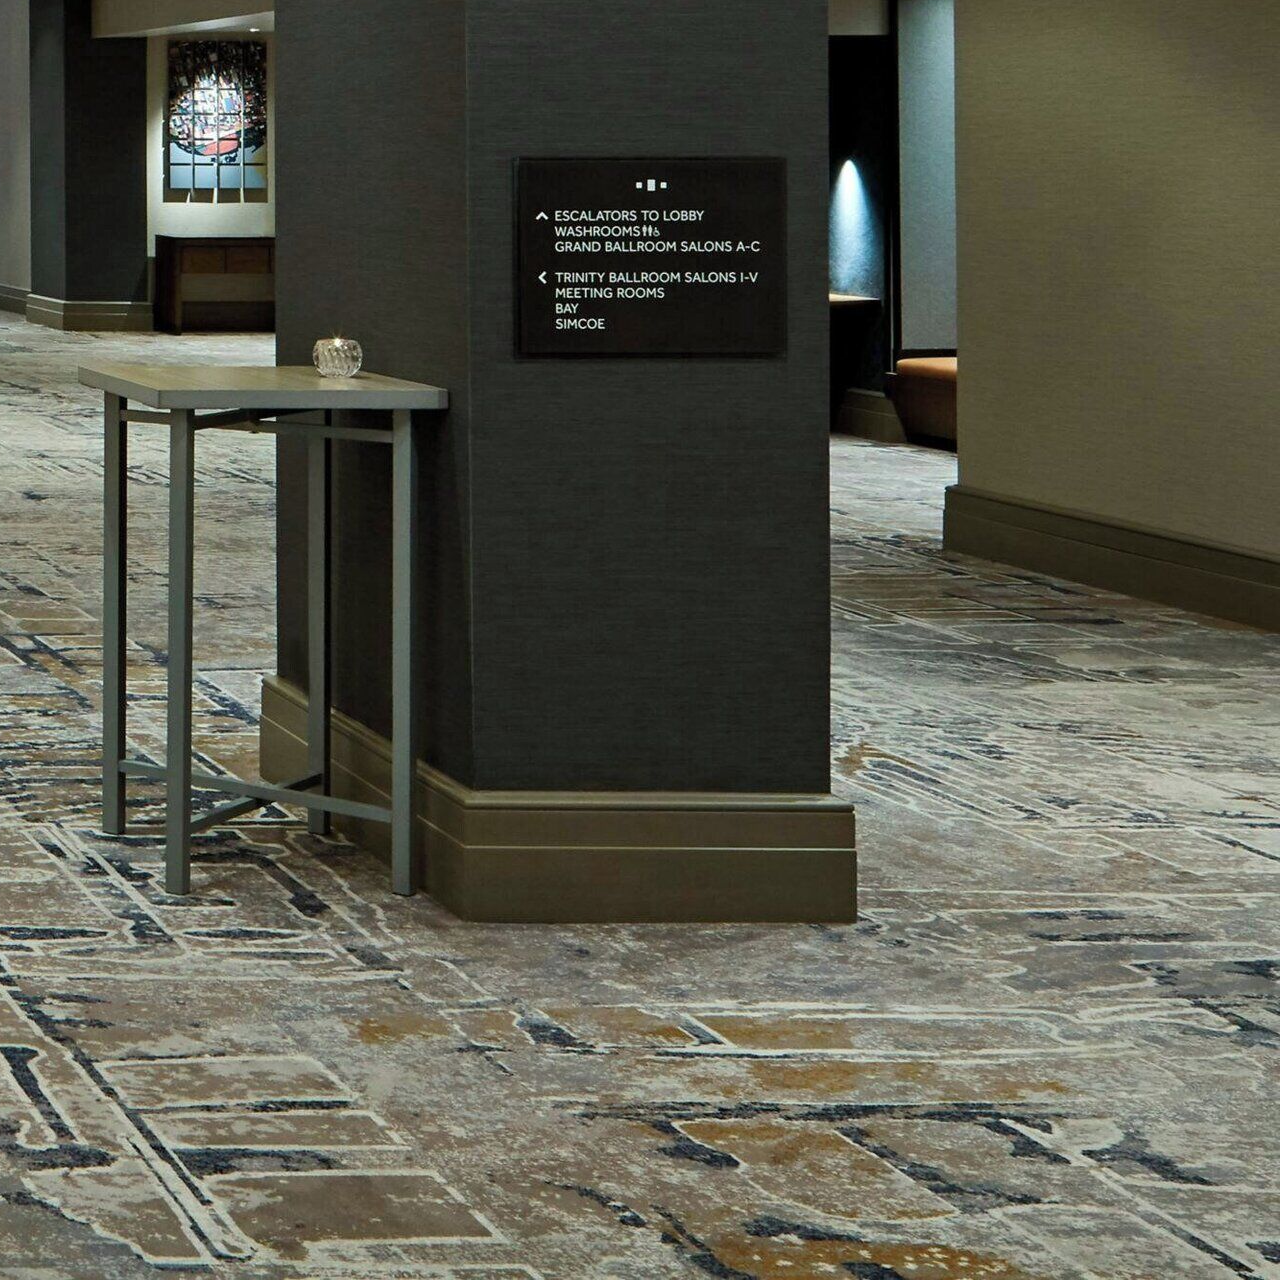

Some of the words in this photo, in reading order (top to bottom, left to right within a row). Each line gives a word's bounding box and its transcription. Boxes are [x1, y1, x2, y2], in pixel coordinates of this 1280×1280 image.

[555, 210, 637, 221] ESCALATORS
[641, 210, 659, 221] TO
[663, 210, 704, 221] LOBBY
[555, 226, 640, 237] WASHROOMS
[555, 241, 601, 252] GRAND
[605, 241, 676, 252] BALLROOM
[681, 241, 732, 252] SALONS
[736, 241, 760, 252] A-C
[555, 272, 605, 283] TRINITY
[609, 272, 680, 283] BALLROOM
[685, 272, 736, 283] SALONS
[741, 272, 758, 282] I-V
[556, 288, 613, 298] MEETING
[617, 288, 664, 298] ROOMS
[556, 303, 578, 313] BAY
[556, 318, 605, 329] SIMCOE
